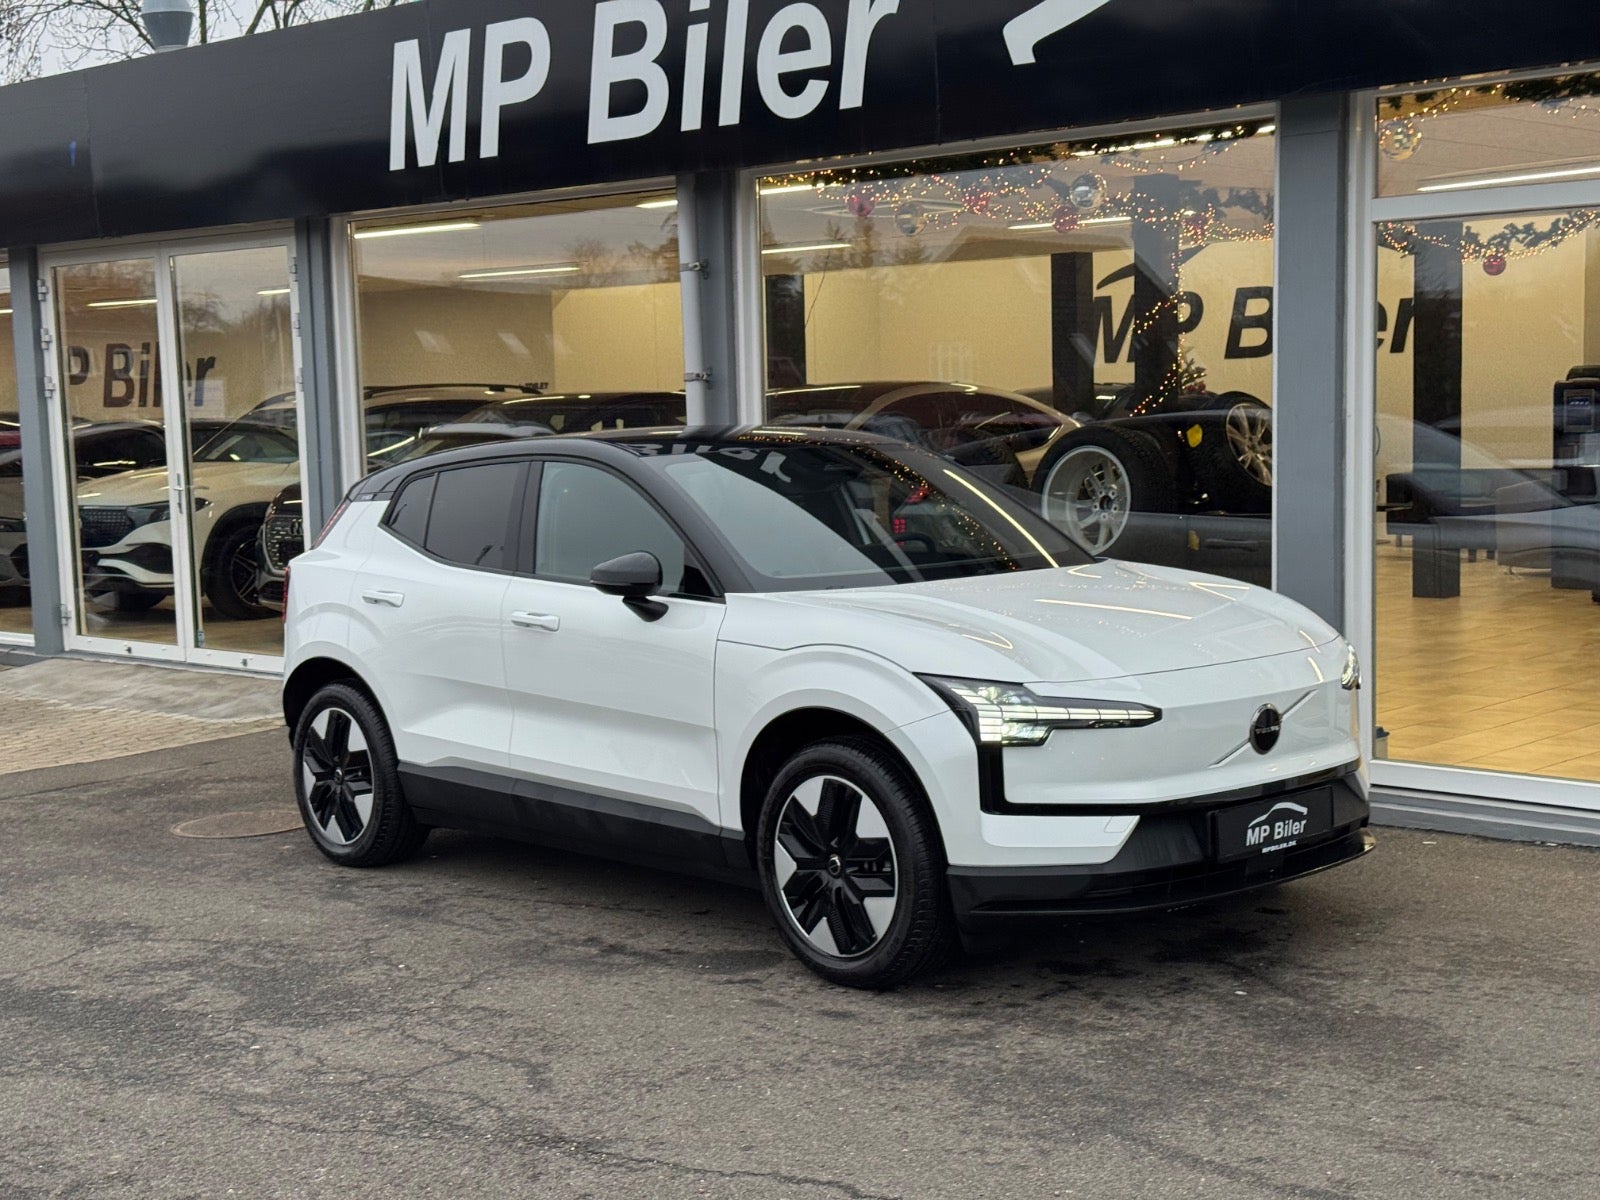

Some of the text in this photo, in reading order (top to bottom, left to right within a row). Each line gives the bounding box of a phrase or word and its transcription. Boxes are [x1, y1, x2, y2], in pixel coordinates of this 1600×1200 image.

[389, 0, 899, 171] MP Biler
[102, 342, 217, 408] Bilr
[1246, 819, 1308, 847] MP Biler
